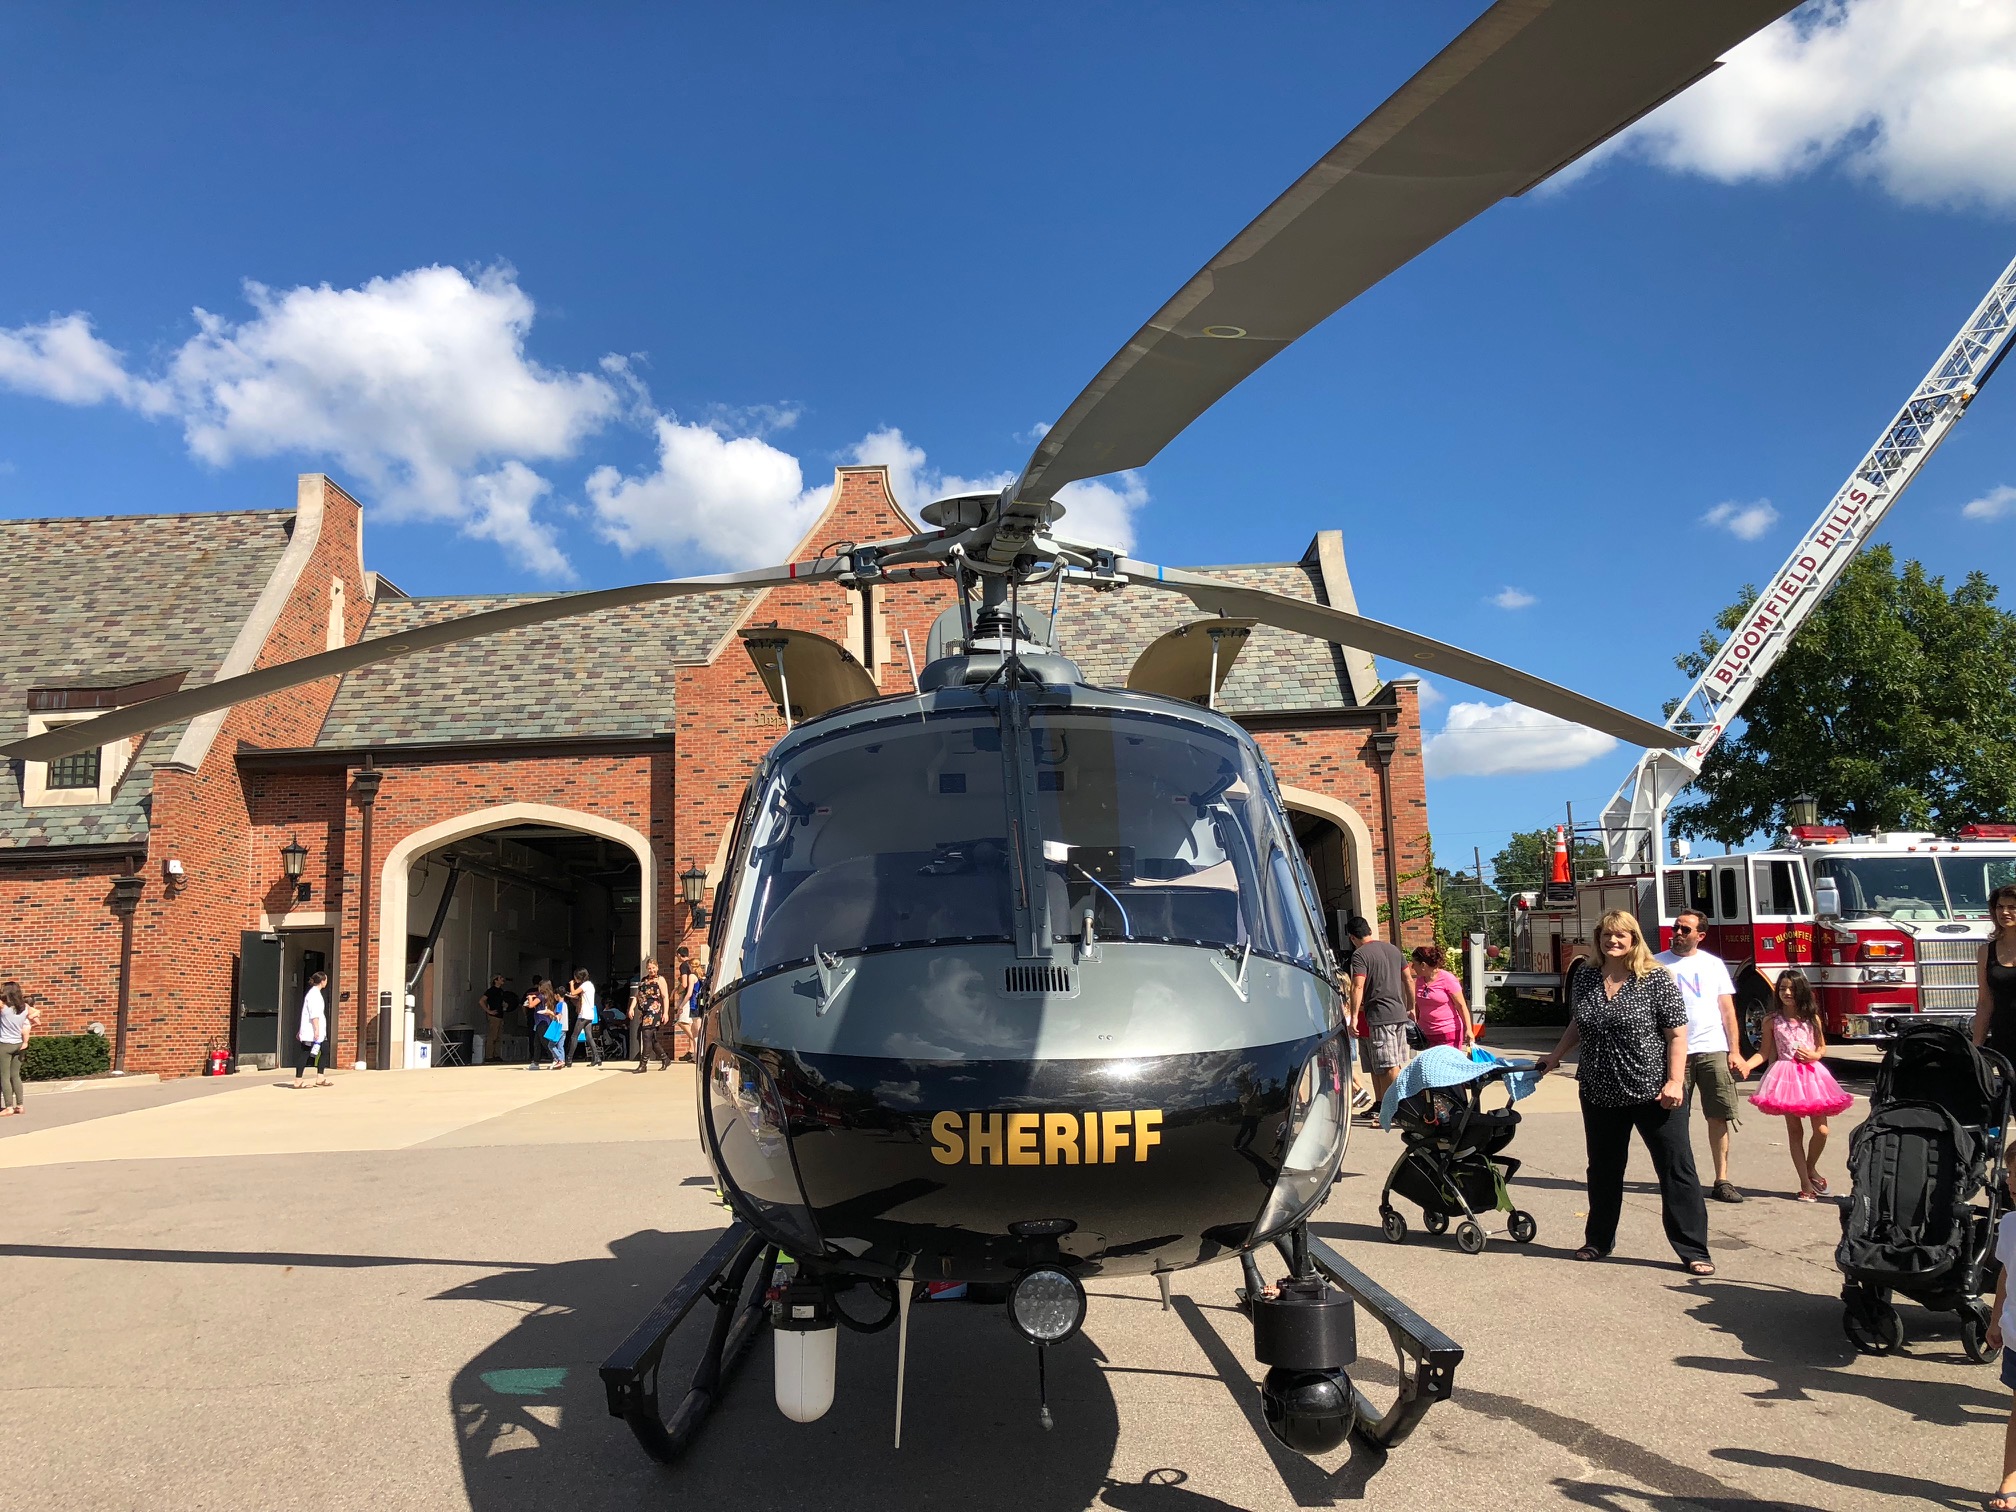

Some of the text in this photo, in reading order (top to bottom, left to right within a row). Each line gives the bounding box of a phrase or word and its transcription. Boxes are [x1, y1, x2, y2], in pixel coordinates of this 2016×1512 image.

[1714, 489, 1868, 685] BLOOMFIELD HILLS
[1788, 944, 1807, 953] HILLS
[931, 1109, 1163, 1166] SHERIFF
